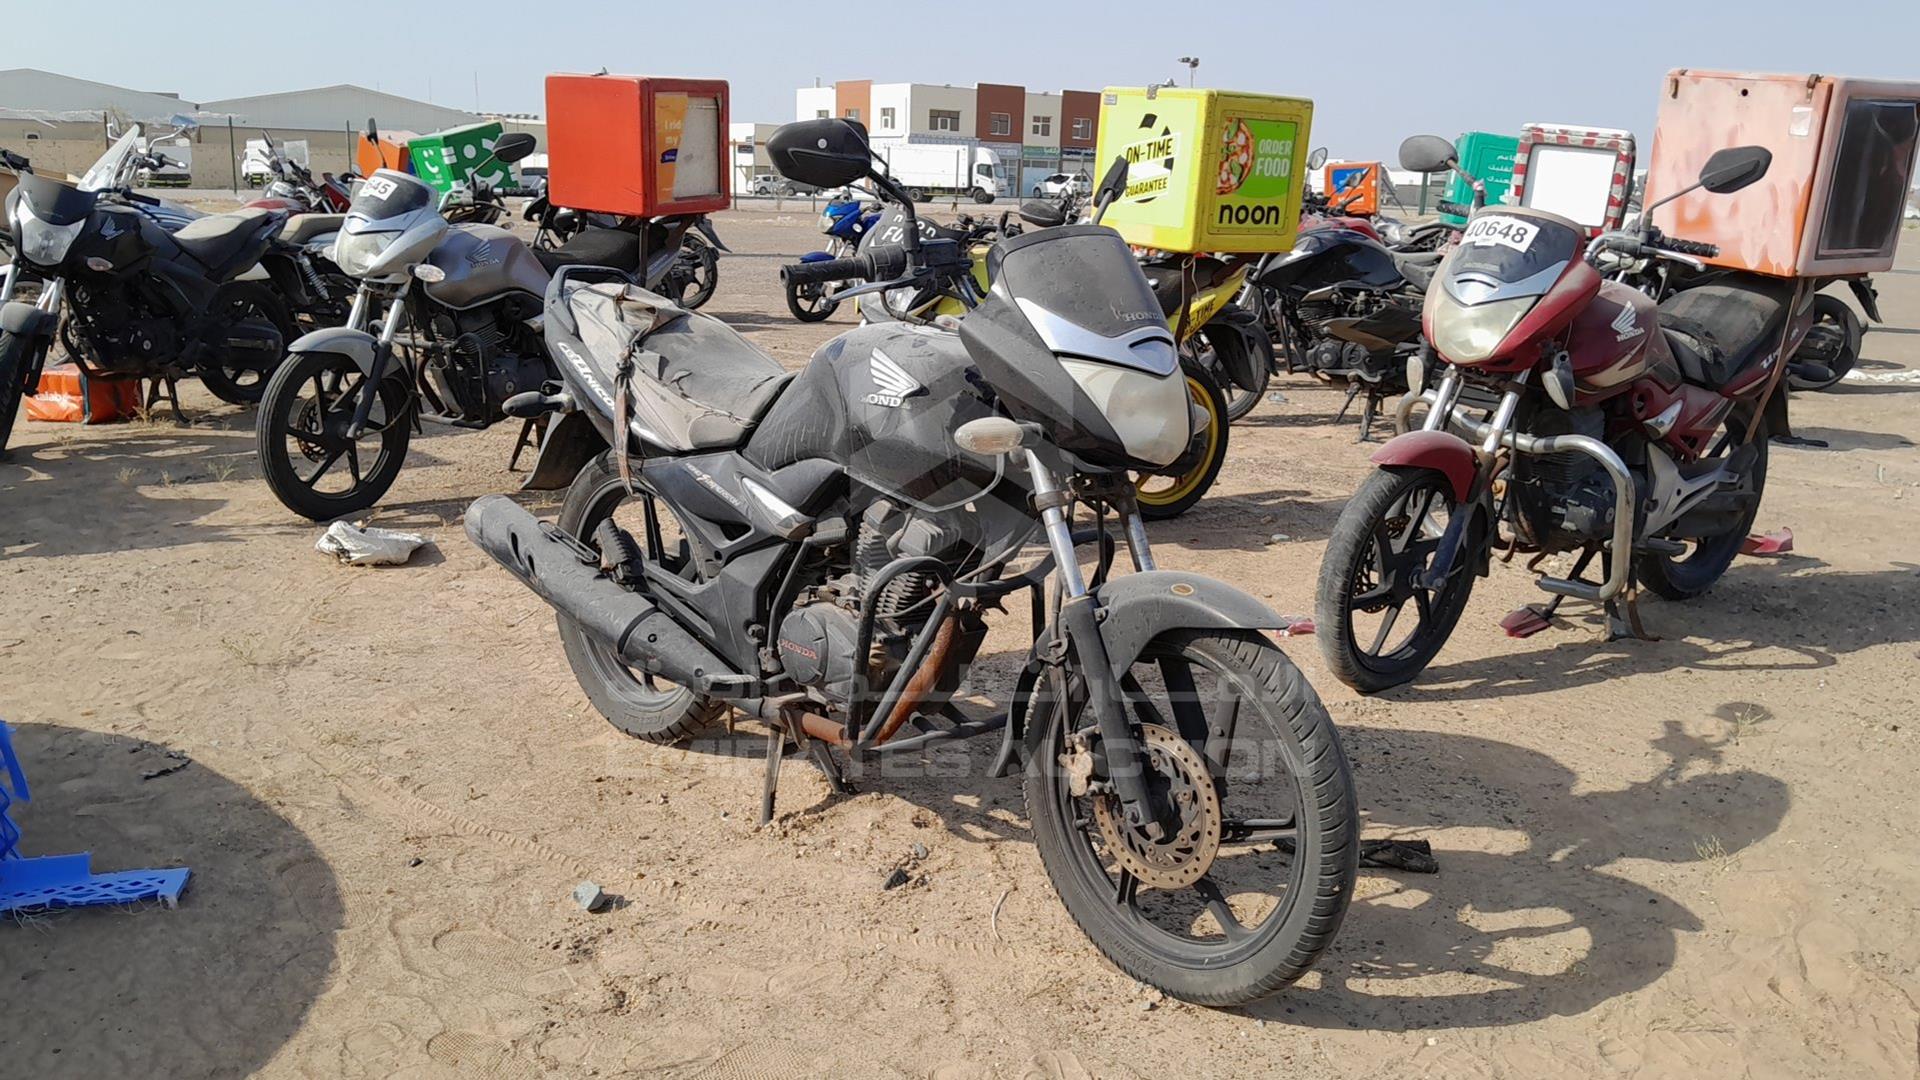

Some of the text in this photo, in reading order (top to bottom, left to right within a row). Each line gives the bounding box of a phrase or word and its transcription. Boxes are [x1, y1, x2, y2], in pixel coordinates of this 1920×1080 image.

[1126, 138, 1173, 164] ON-TIME
[1258, 139, 1292, 155] ORDER
[1255, 157, 1290, 177] FOOD
[1125, 177, 1168, 197] GUARANTEE
[1218, 204, 1280, 225] noon
[780, 638, 818, 660] HONDA
